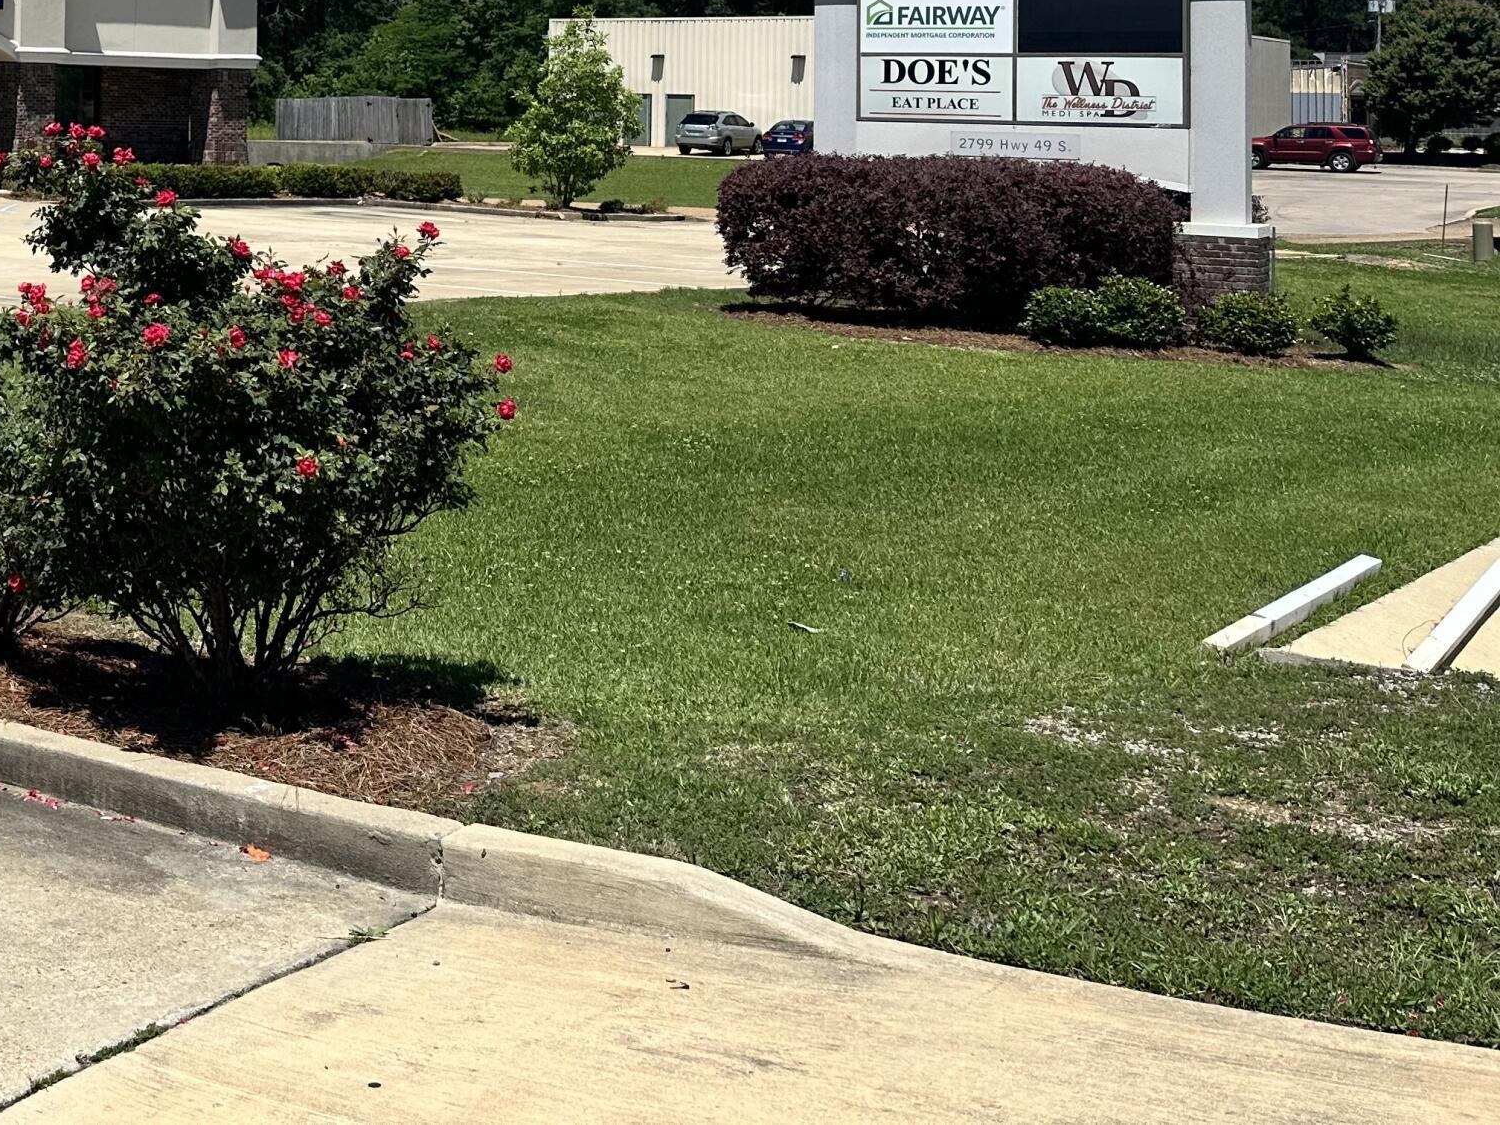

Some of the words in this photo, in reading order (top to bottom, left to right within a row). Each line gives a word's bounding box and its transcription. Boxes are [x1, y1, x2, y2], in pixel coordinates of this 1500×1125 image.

[897, 5, 1001, 25] FAIRWAY
[880, 58, 992, 86] DOE'S
[891, 96, 924, 109] EAT
[927, 97, 980, 110] PLACE
[1041, 96, 1058, 110] The
[1063, 96, 1108, 110] Wellness
[1111, 97, 1156, 110] District
[1079, 110, 1101, 118] SPA
[959, 137, 994, 149] 2799
[1000, 139, 1029, 153] Hwy
[1034, 139, 1052, 151] 49
